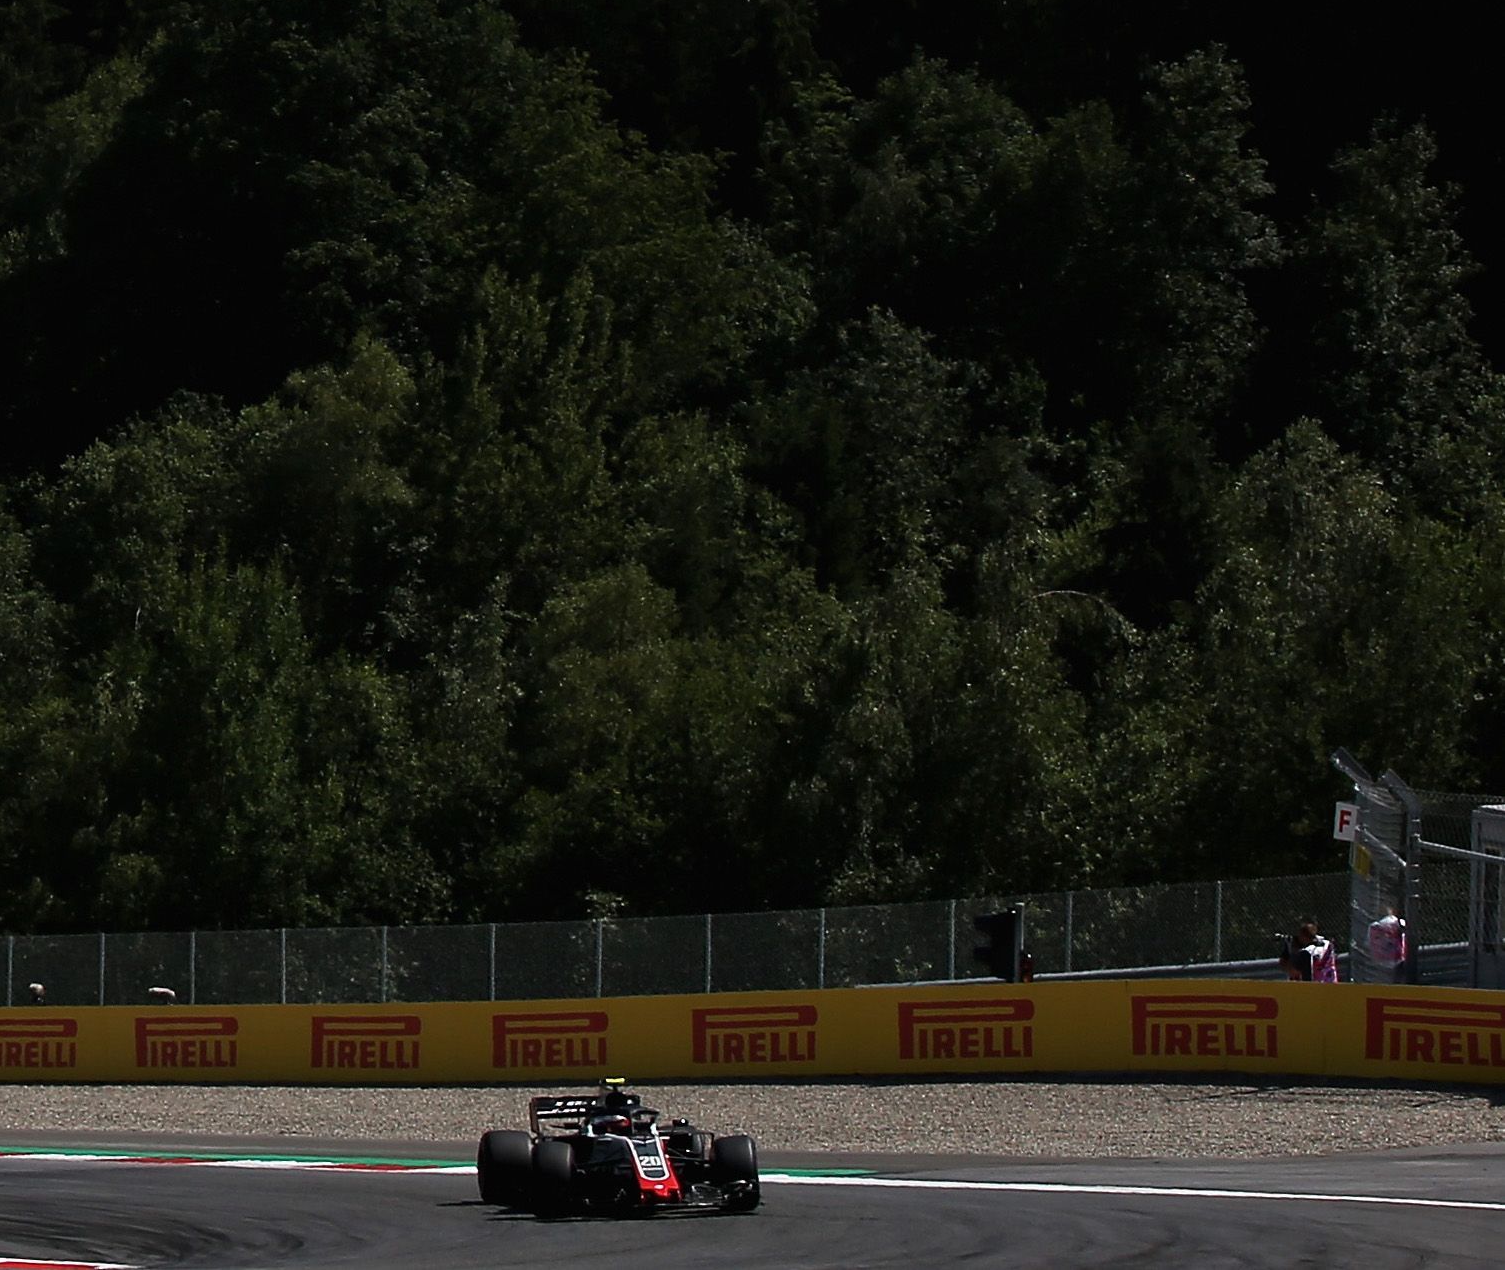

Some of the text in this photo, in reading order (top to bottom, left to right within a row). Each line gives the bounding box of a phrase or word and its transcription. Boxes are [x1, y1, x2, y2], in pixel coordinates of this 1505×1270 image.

[1338, 809, 1351, 832] F
[135, 1016, 239, 1068] PIRELLI
[311, 1016, 421, 1069] PIRELLI
[493, 1011, 609, 1068] PIRELLI
[692, 1005, 818, 1064] PIRELLI
[898, 999, 1035, 1060] PIRELLI
[1131, 995, 1279, 1058] PIRELLI
[1365, 997, 1505, 1067] PIRELL
[639, 1155, 661, 1166] 20
